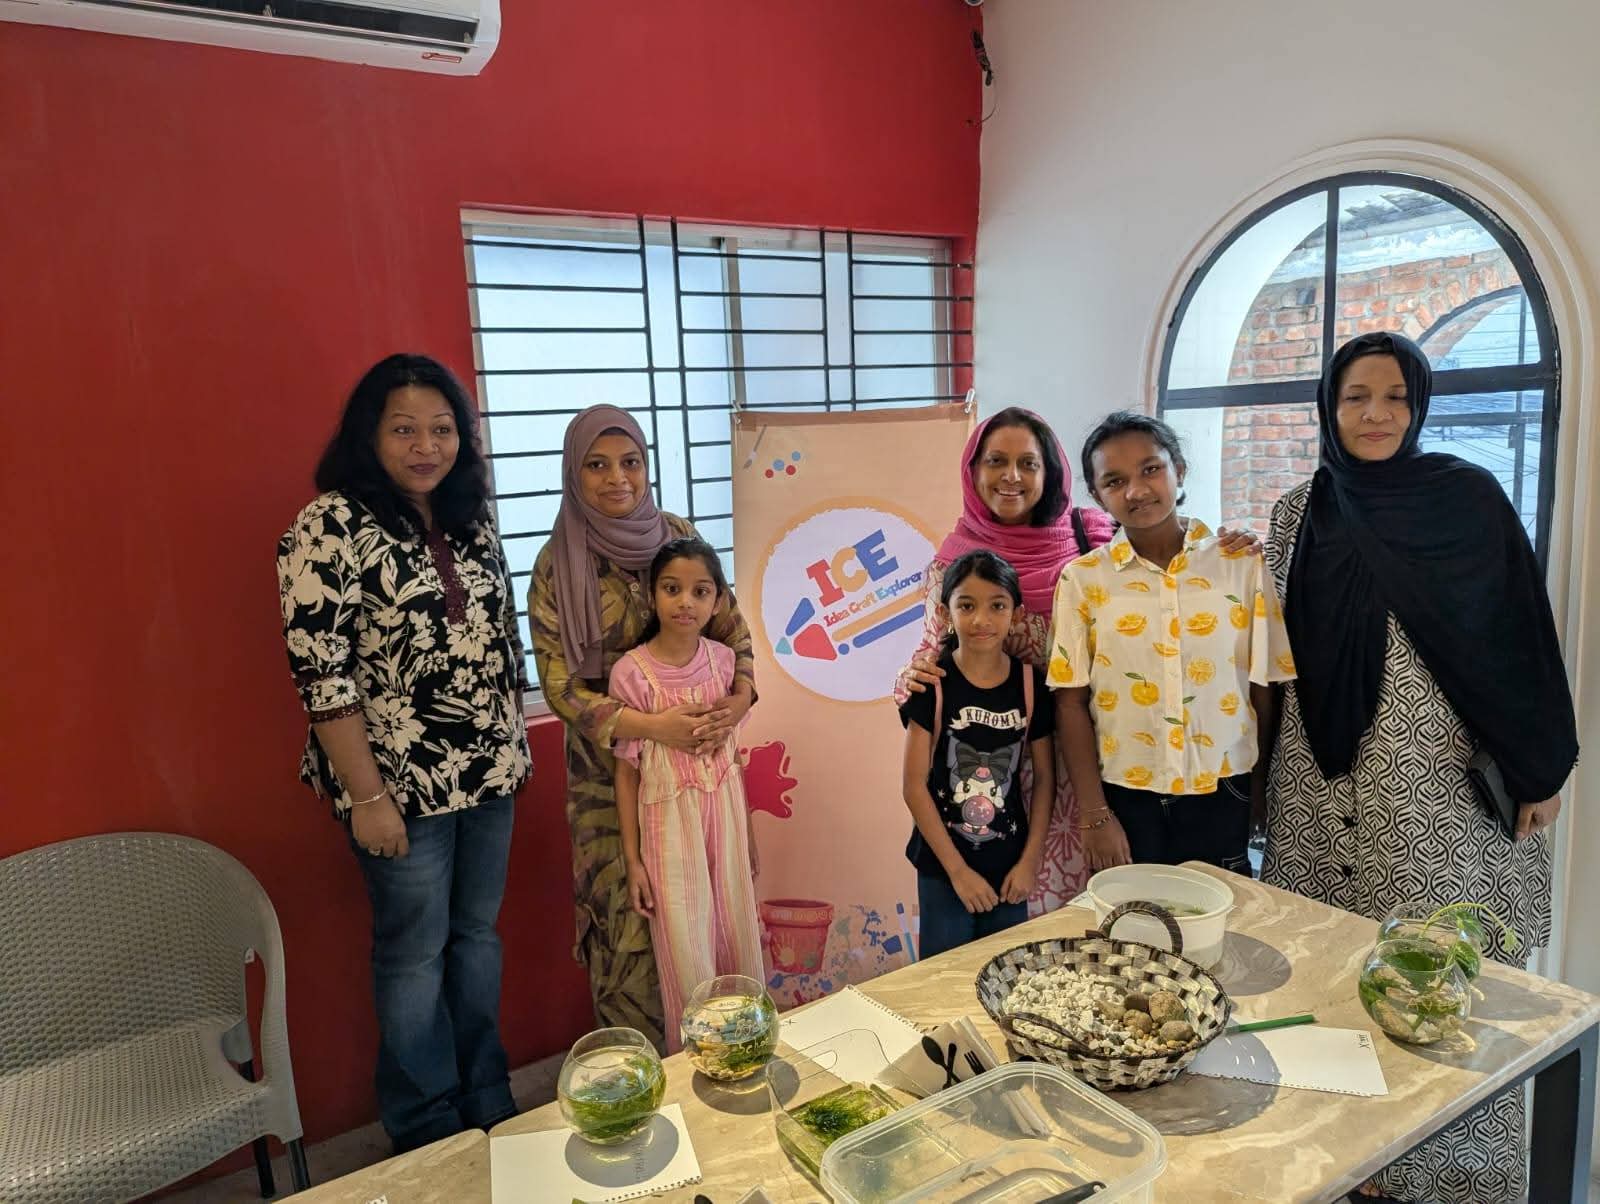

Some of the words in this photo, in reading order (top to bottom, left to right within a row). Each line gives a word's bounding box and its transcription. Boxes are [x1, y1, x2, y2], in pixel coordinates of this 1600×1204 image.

[806, 529, 899, 607] ICE
[824, 611, 850, 627] Idea
[849, 592, 877, 613] Craft
[875, 571, 922, 600] Explorer
[966, 708, 1017, 727] KUROMI
